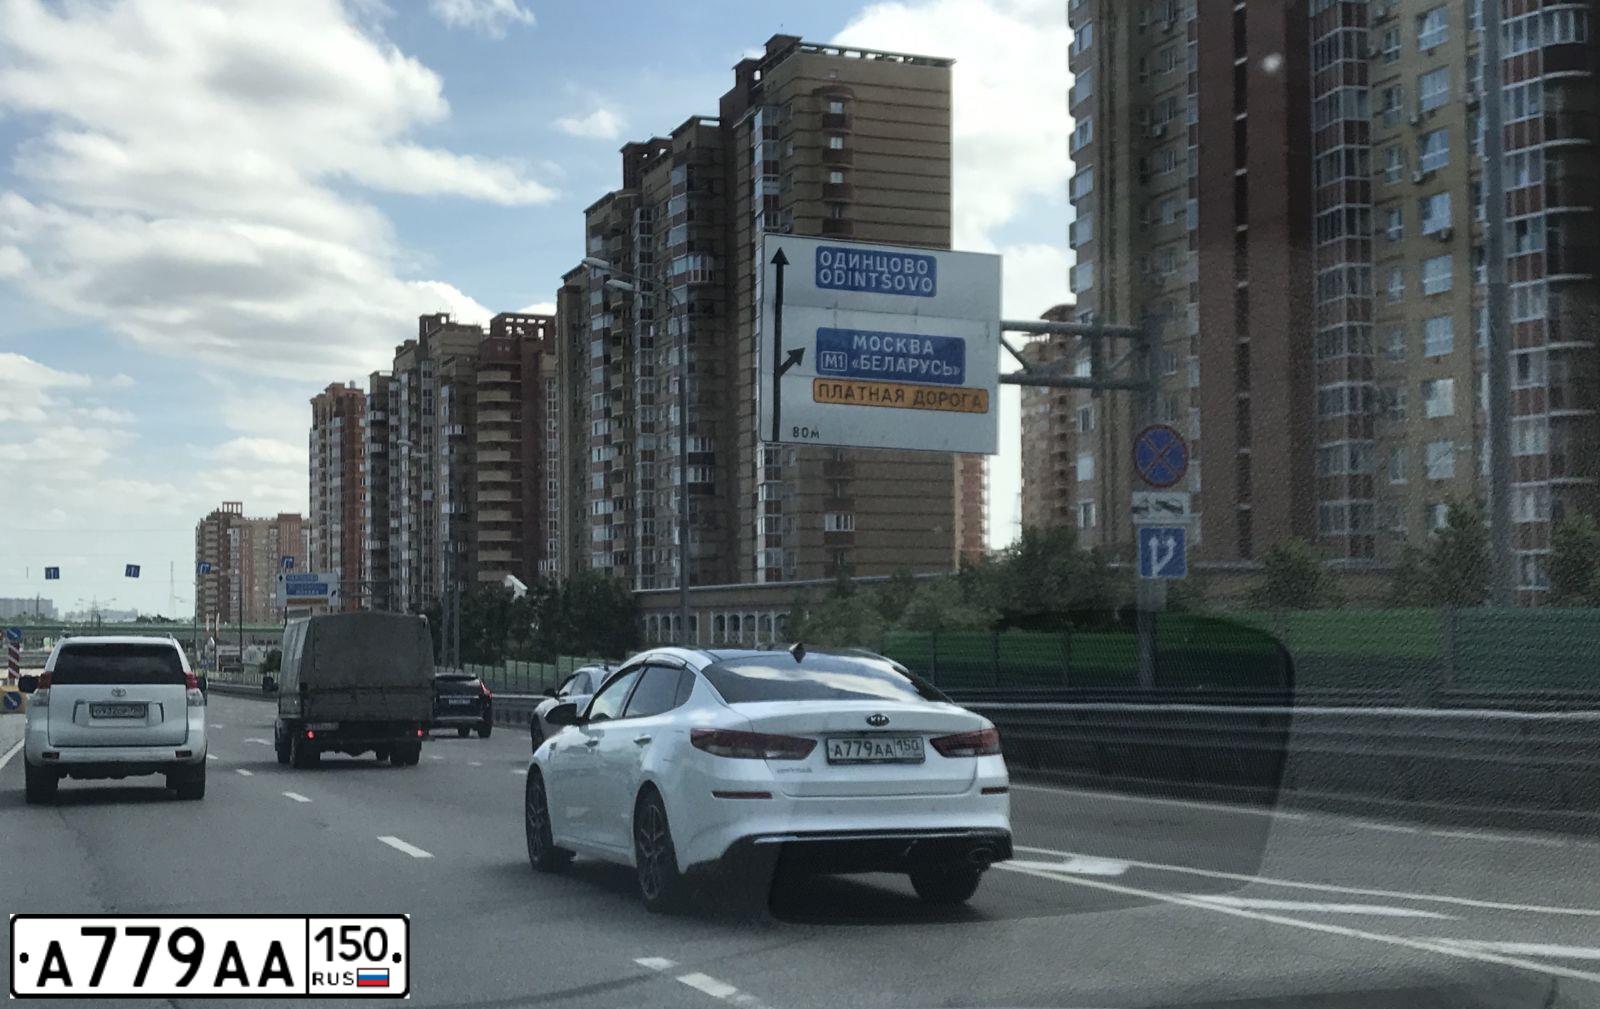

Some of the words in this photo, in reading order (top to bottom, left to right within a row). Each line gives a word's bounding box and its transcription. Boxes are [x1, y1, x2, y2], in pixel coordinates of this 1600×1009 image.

[819, 251, 929, 275] ОДИНЦОВО
[820, 268, 934, 293] ODINTSOVO
[852, 335, 935, 355] МОСКВА
[824, 353, 845, 369] М1
[852, 354, 961, 376] «БЕЛАРУСЬ»
[818, 383, 905, 403] ПЛАТНАЯ
[912, 389, 984, 408] ДОРОГА
